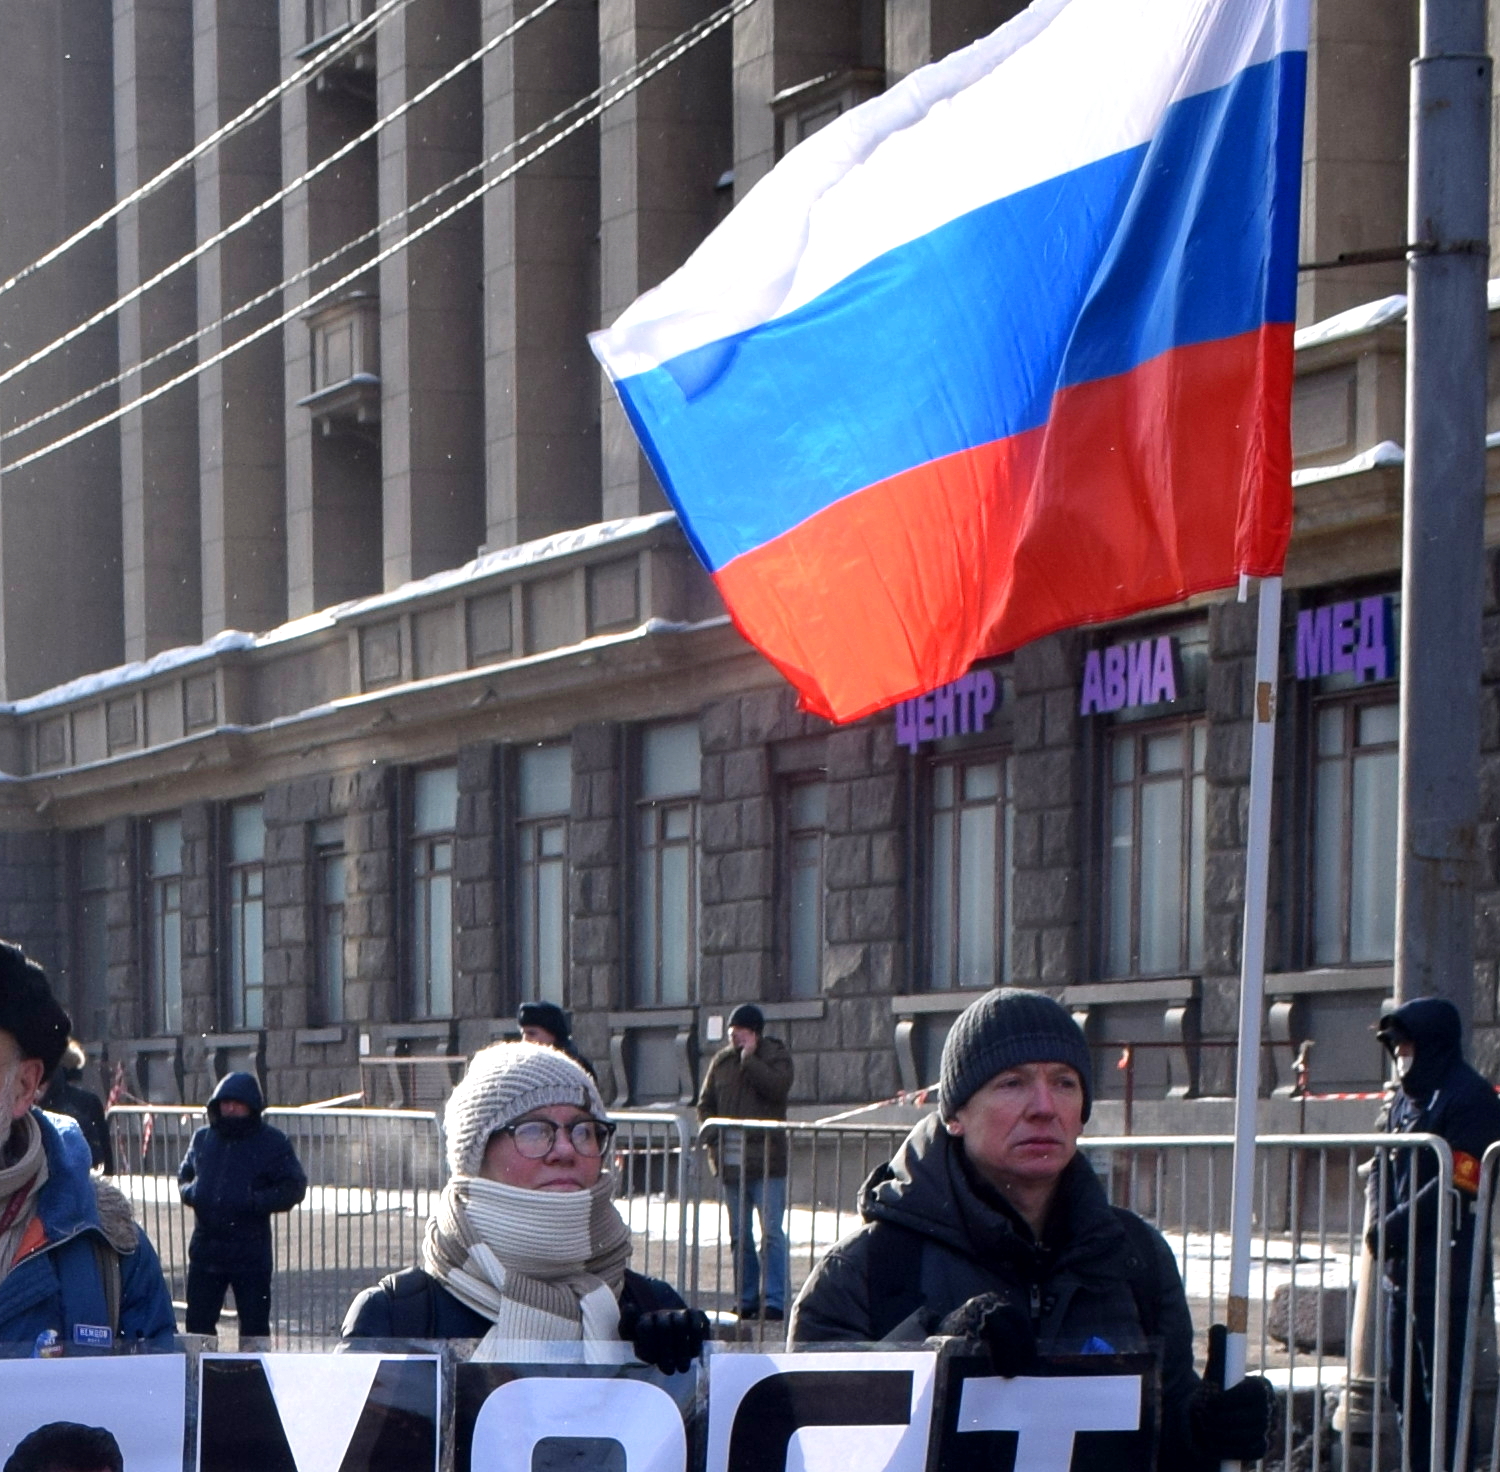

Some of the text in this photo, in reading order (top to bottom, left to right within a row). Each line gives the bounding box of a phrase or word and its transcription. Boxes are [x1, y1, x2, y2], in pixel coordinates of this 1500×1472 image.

[897, 597, 1391, 754] ЦЕНТР АВИА МЕД
